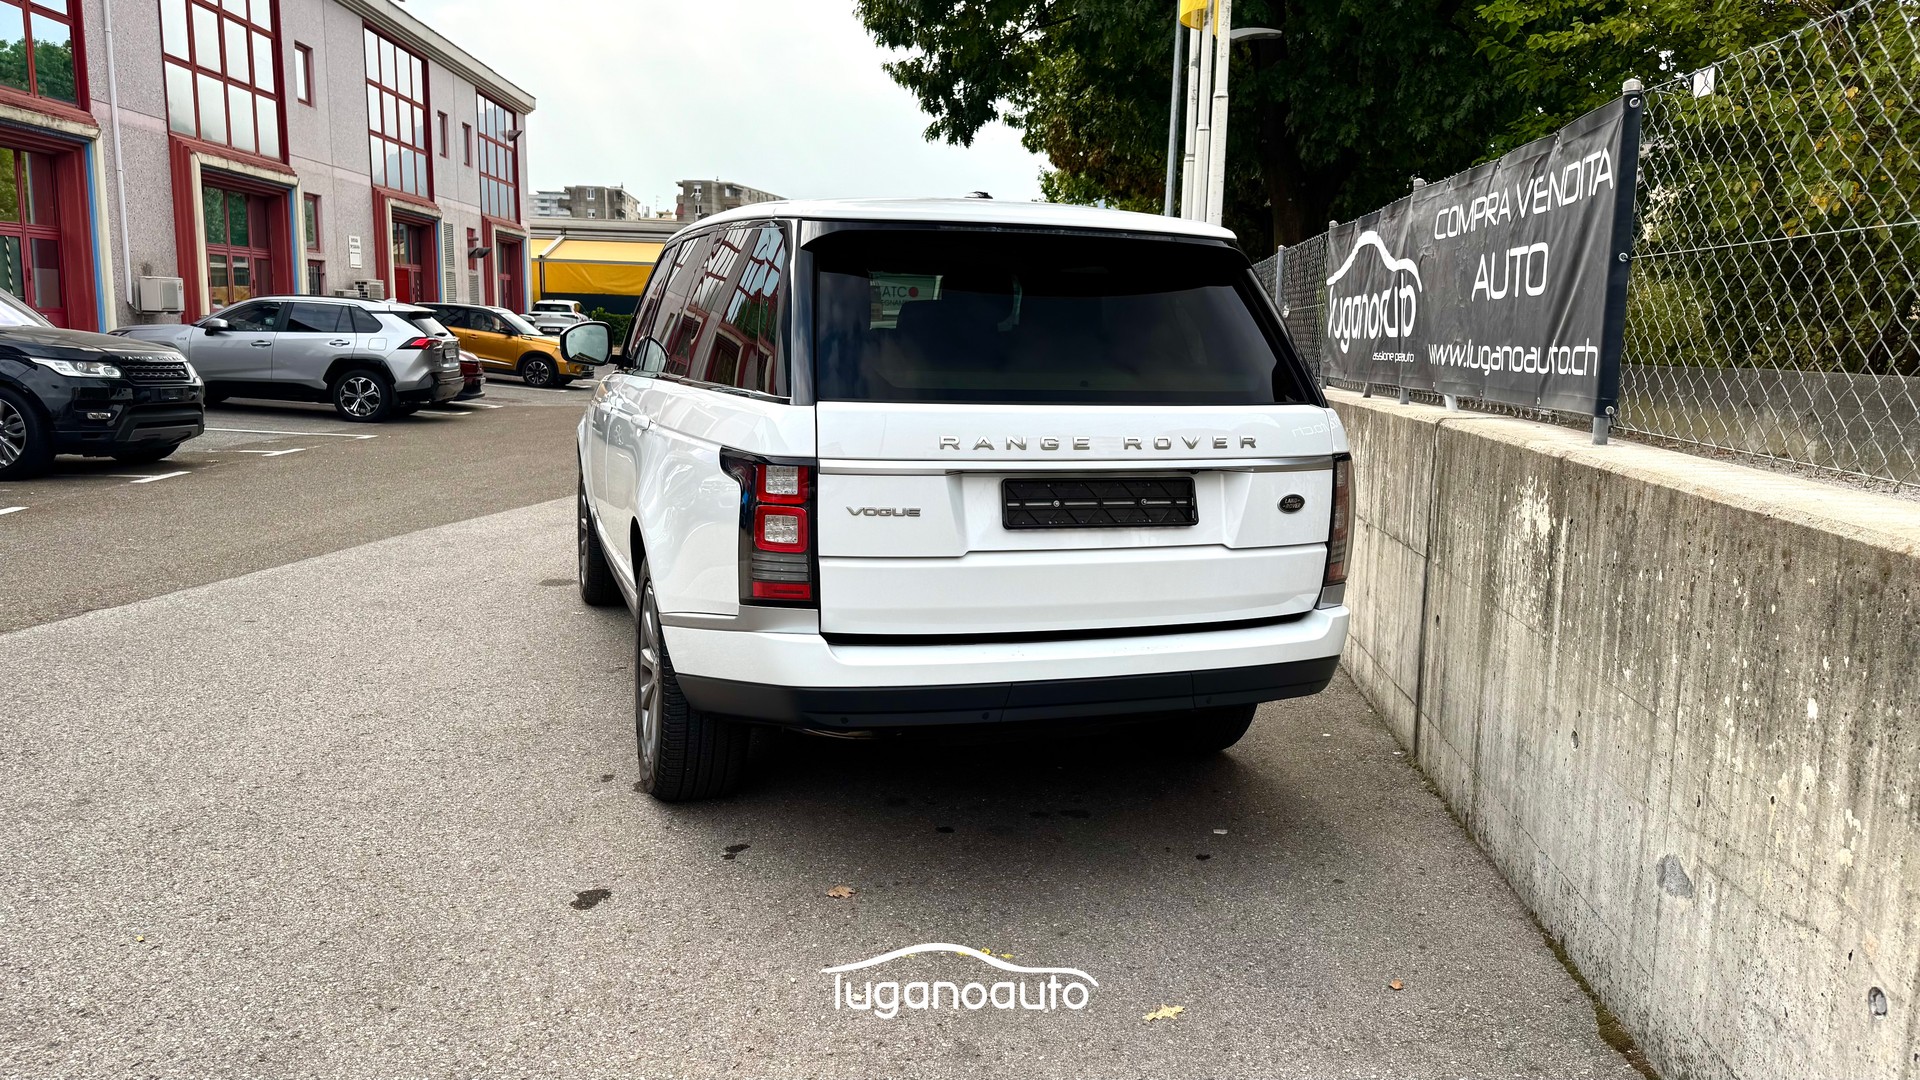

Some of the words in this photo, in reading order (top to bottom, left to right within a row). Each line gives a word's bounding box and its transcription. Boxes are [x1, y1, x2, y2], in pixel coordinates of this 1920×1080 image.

[1434, 187, 1511, 240] COMPRA
[1516, 147, 1614, 219] VENDITA
[1471, 242, 1549, 302] AUTO
[1428, 338, 1599, 376] www.luganoauto.ch
[939, 435, 1091, 451] RANGE
[1123, 435, 1257, 450] ROVER
[846, 506, 921, 517] VOGUE
